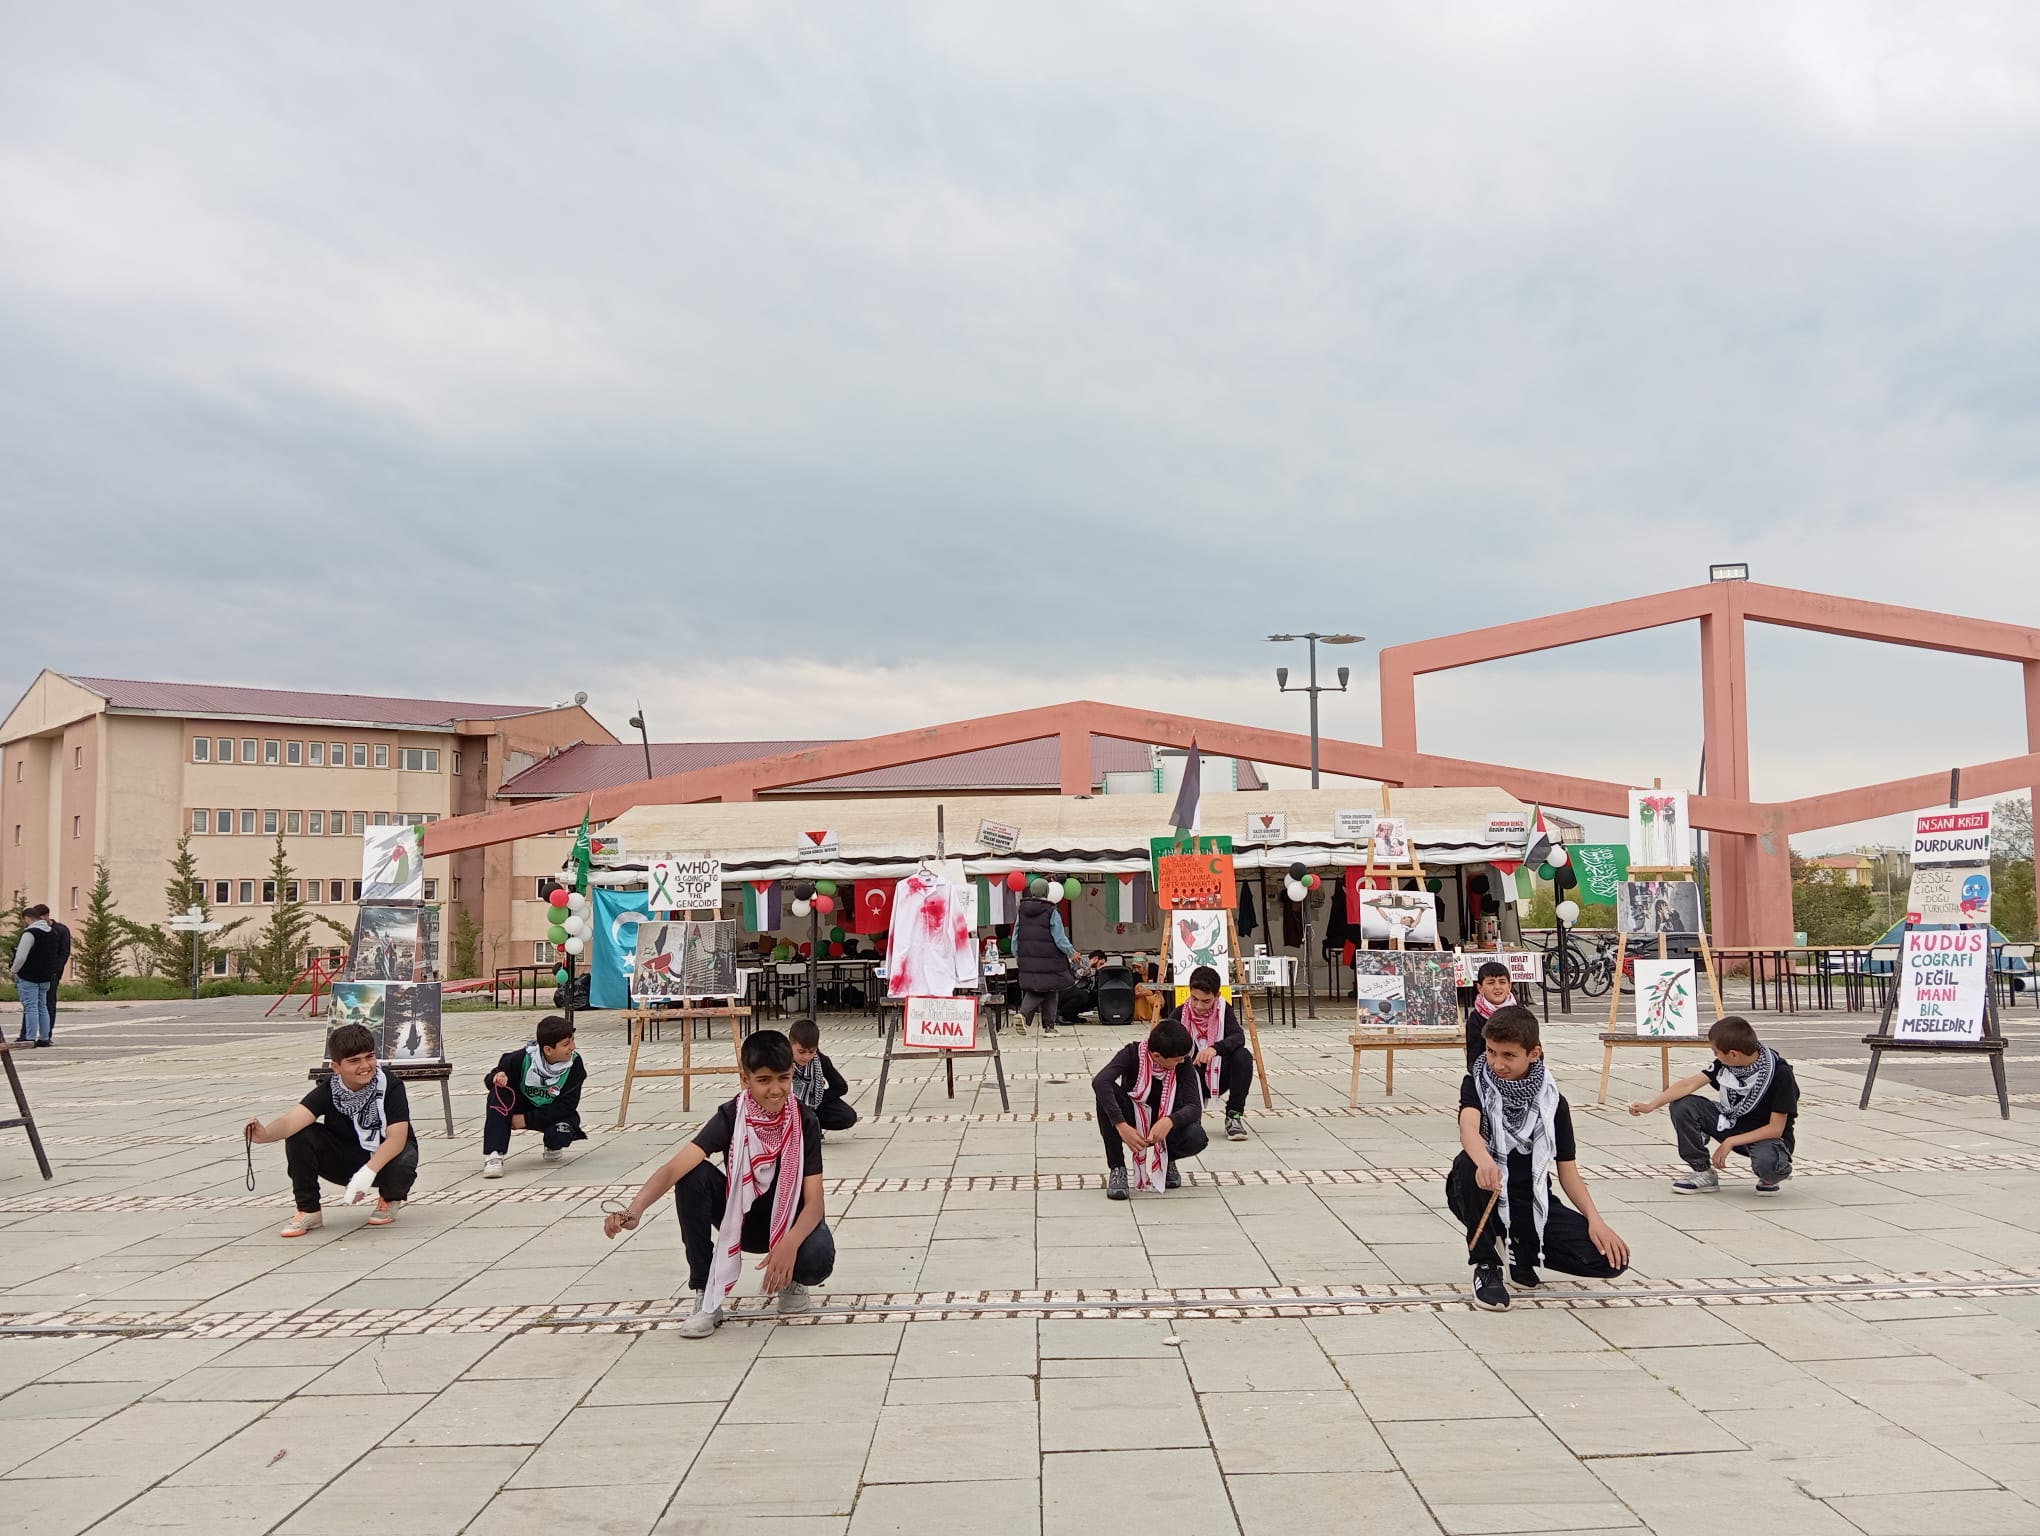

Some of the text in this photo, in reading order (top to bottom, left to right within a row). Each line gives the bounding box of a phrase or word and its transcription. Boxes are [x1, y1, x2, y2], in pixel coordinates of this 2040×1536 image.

[1914, 834, 1990, 853] DURDURUN!
[676, 859, 719, 874] WHO?
[676, 881, 712, 893] STOP
[676, 899, 719, 908] GENCOIDE
[1910, 932, 1982, 952] KUDÜS
[1510, 955, 1529, 963] DEVLET
[1914, 968, 1960, 986] DEĞİL
[1916, 985, 1957, 1001] İMANİ
[921, 1020, 964, 1037] KANA
[1902, 1017, 1974, 1034] MESELEDİR!
